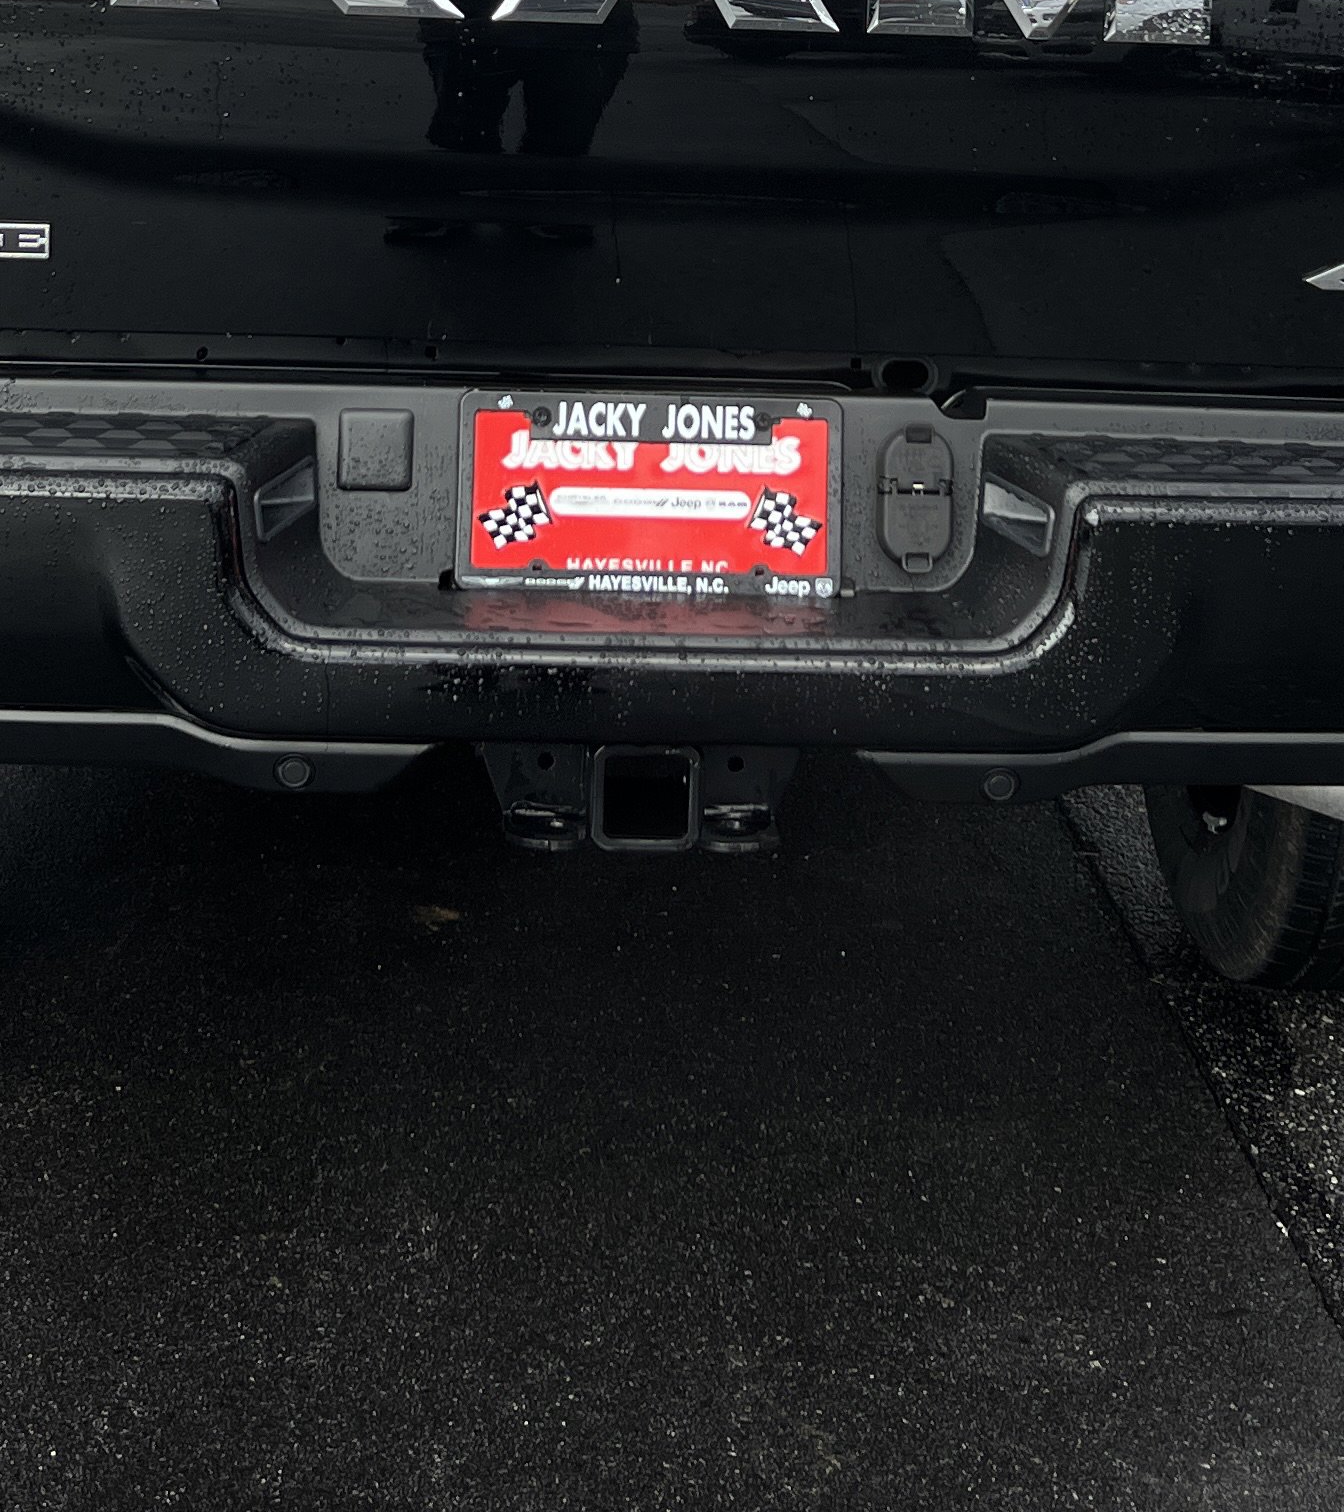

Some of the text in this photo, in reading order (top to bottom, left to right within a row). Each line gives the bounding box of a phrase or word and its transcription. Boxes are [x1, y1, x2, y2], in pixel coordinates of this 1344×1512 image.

[553, 400, 757, 440] JACKY JONES
[501, 429, 802, 476] JACKY JONES
[671, 497, 702, 509] Jeep
[695, 577, 730, 594] N.C.
[764, 576, 811, 597] Jeep
